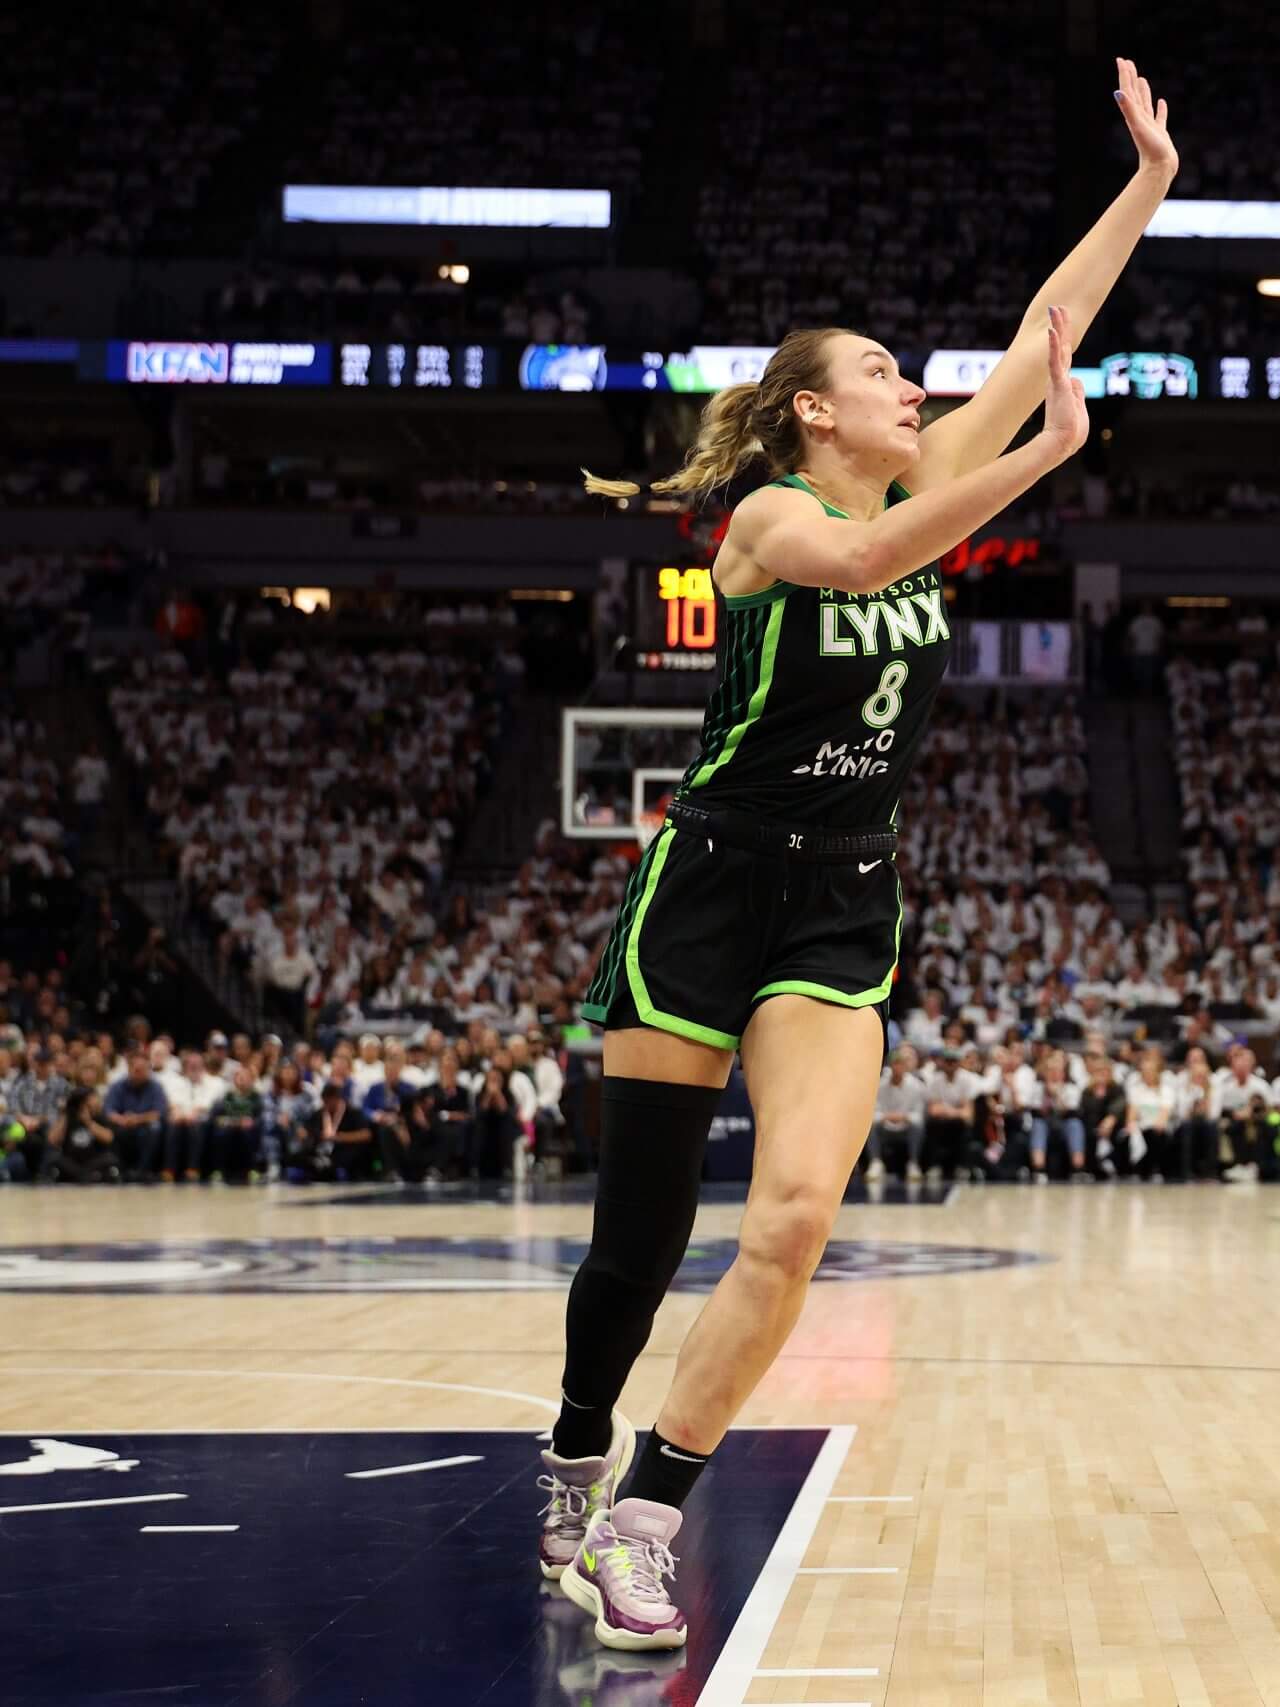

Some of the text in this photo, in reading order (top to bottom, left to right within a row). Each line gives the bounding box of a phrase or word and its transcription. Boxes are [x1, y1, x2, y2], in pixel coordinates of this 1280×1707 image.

[666, 600, 716, 648] 10
[819, 589, 950, 657] LYNX
[861, 660, 909, 729] 8
